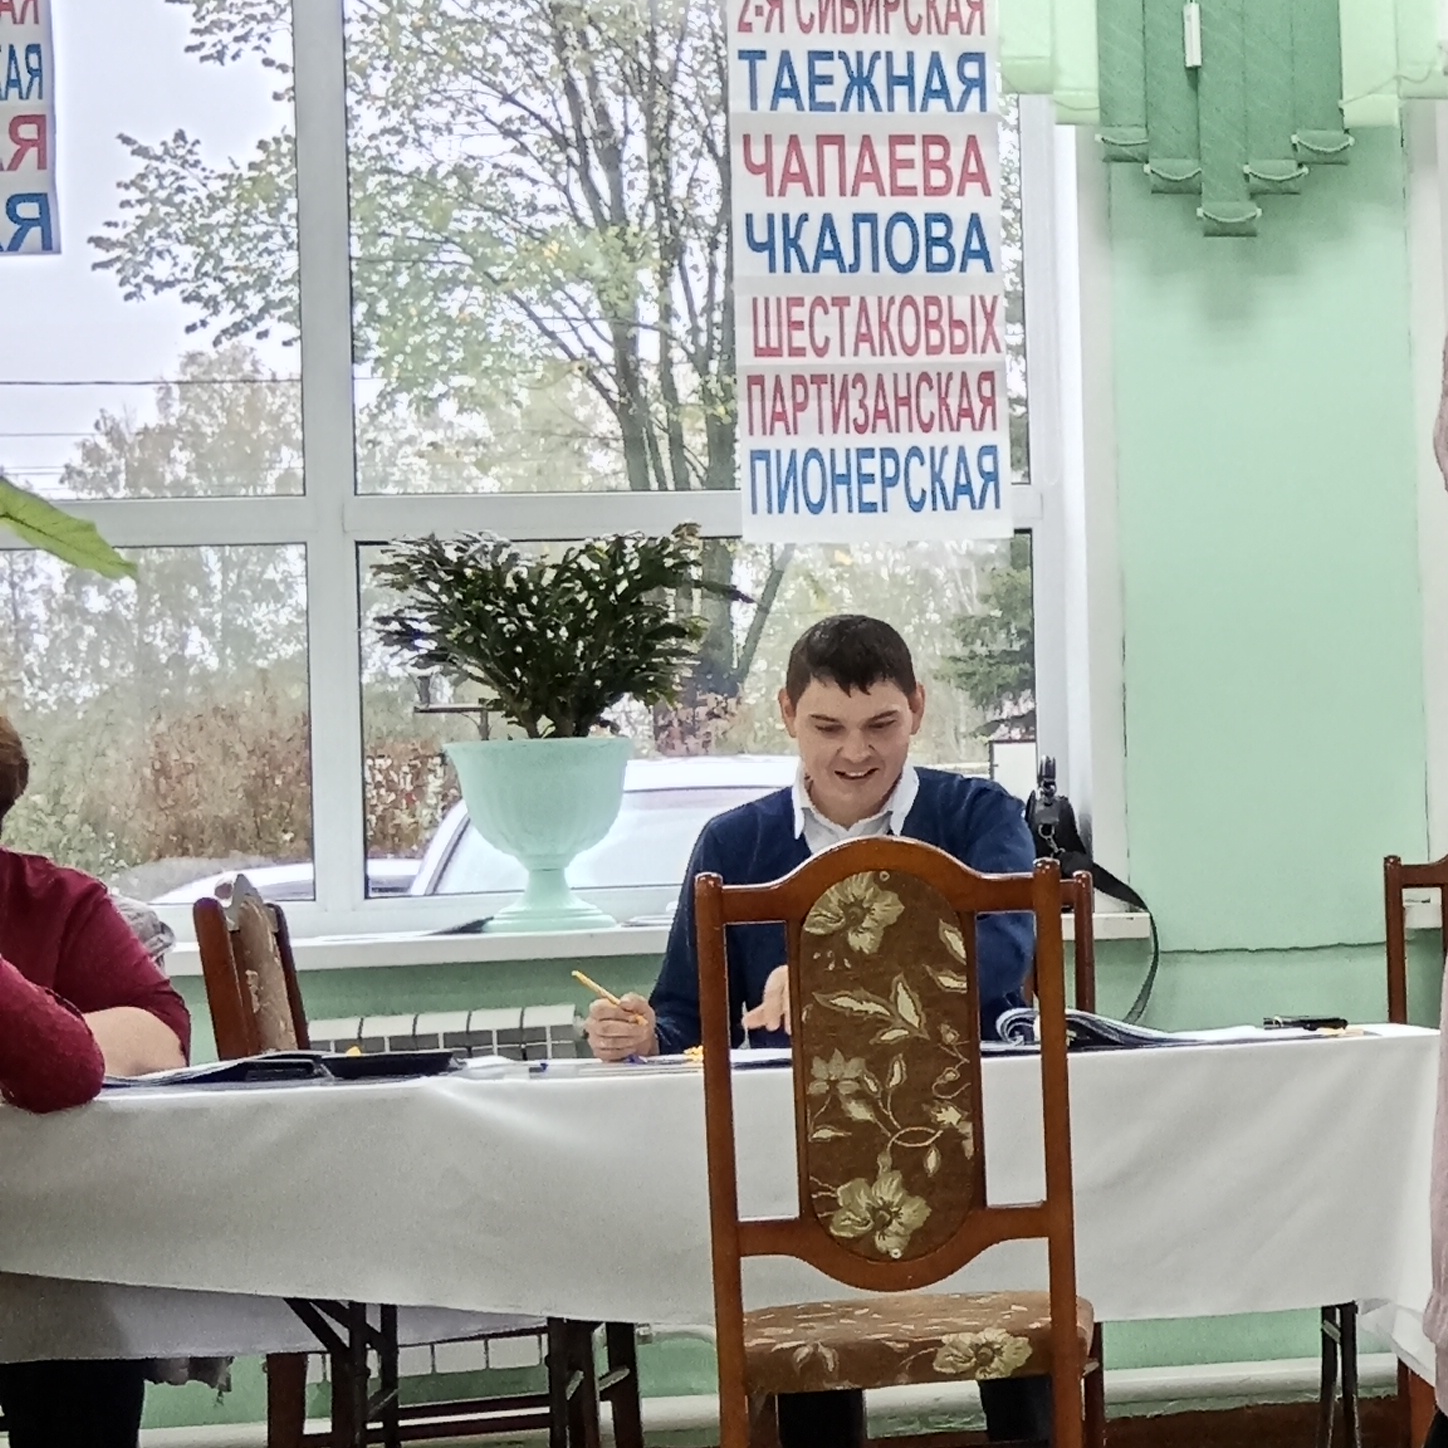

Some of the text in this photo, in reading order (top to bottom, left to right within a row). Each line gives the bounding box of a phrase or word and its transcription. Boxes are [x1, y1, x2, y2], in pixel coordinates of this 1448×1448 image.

[738, 49, 987, 113] ТАЕЖНАЯ
[742, 134, 991, 198] ЧАПАЕВА
[745, 212, 994, 275] ЧКАЛОВА
[751, 294, 1003, 359] ШЕСТАКОВЫХ
[747, 370, 998, 437] ПАРТИЗАНСКАЯ
[749, 445, 1001, 516] ПИОНЕРСКАЯ
